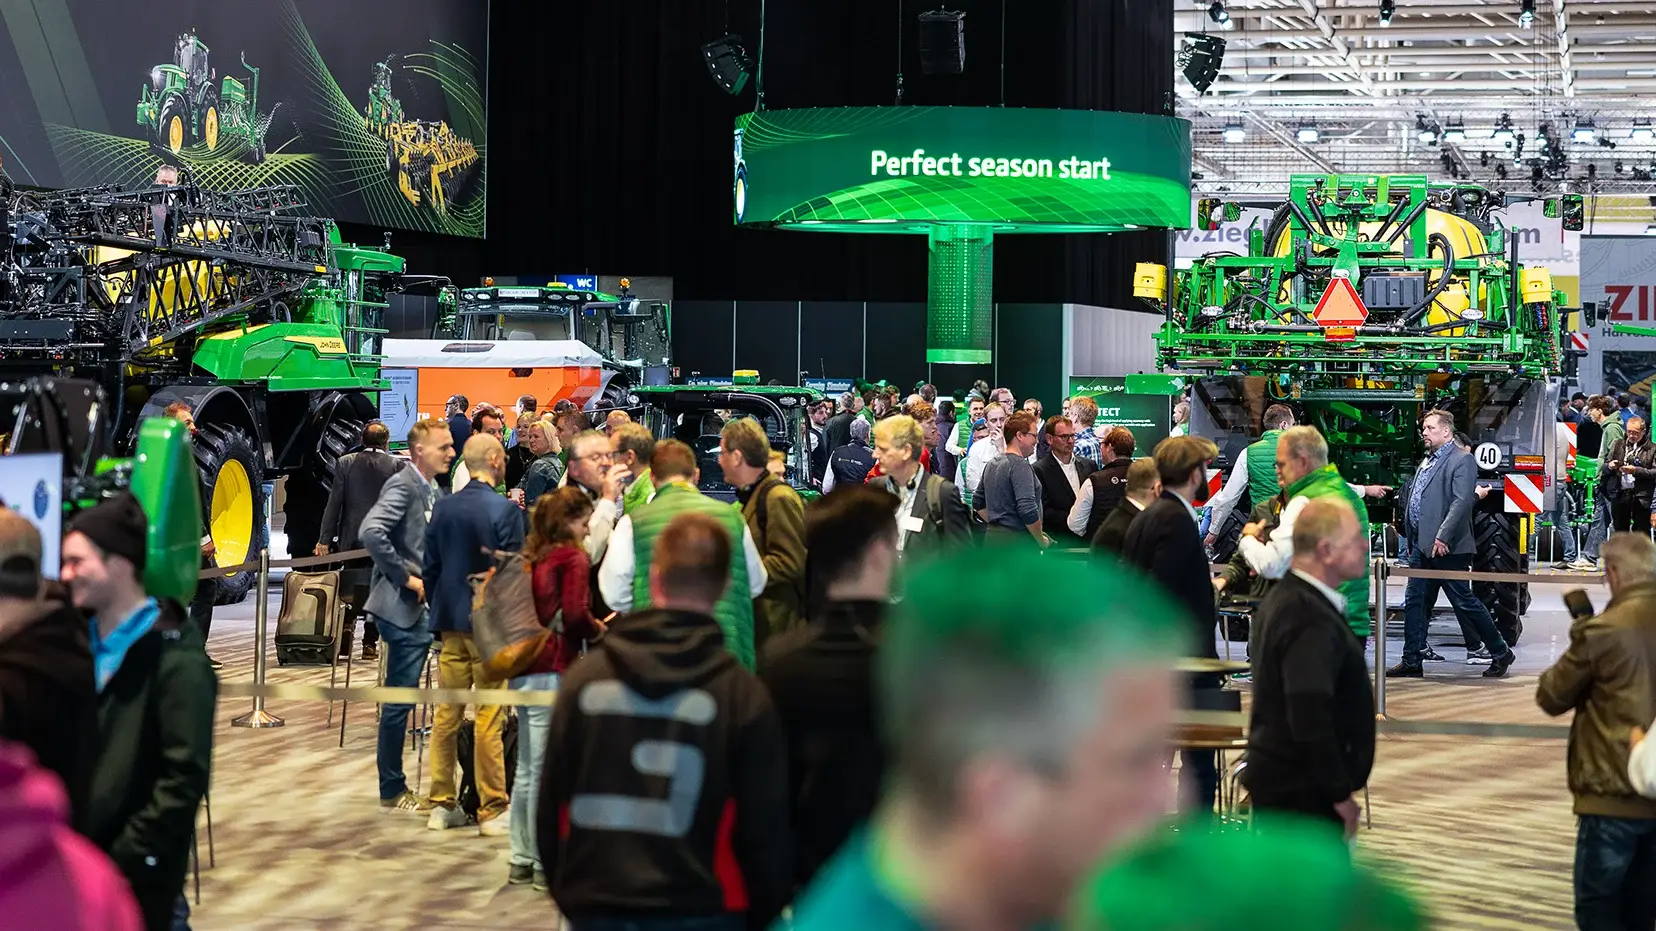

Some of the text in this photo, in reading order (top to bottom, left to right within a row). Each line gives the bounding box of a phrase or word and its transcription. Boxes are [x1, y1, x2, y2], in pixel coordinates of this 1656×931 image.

[870, 148, 1112, 180] Perfect season start
[576, 278, 592, 288] WC
[1604, 285, 1656, 321] ZI
[1097, 407, 1121, 417] TECT
[1479, 447, 1496, 465] 40
